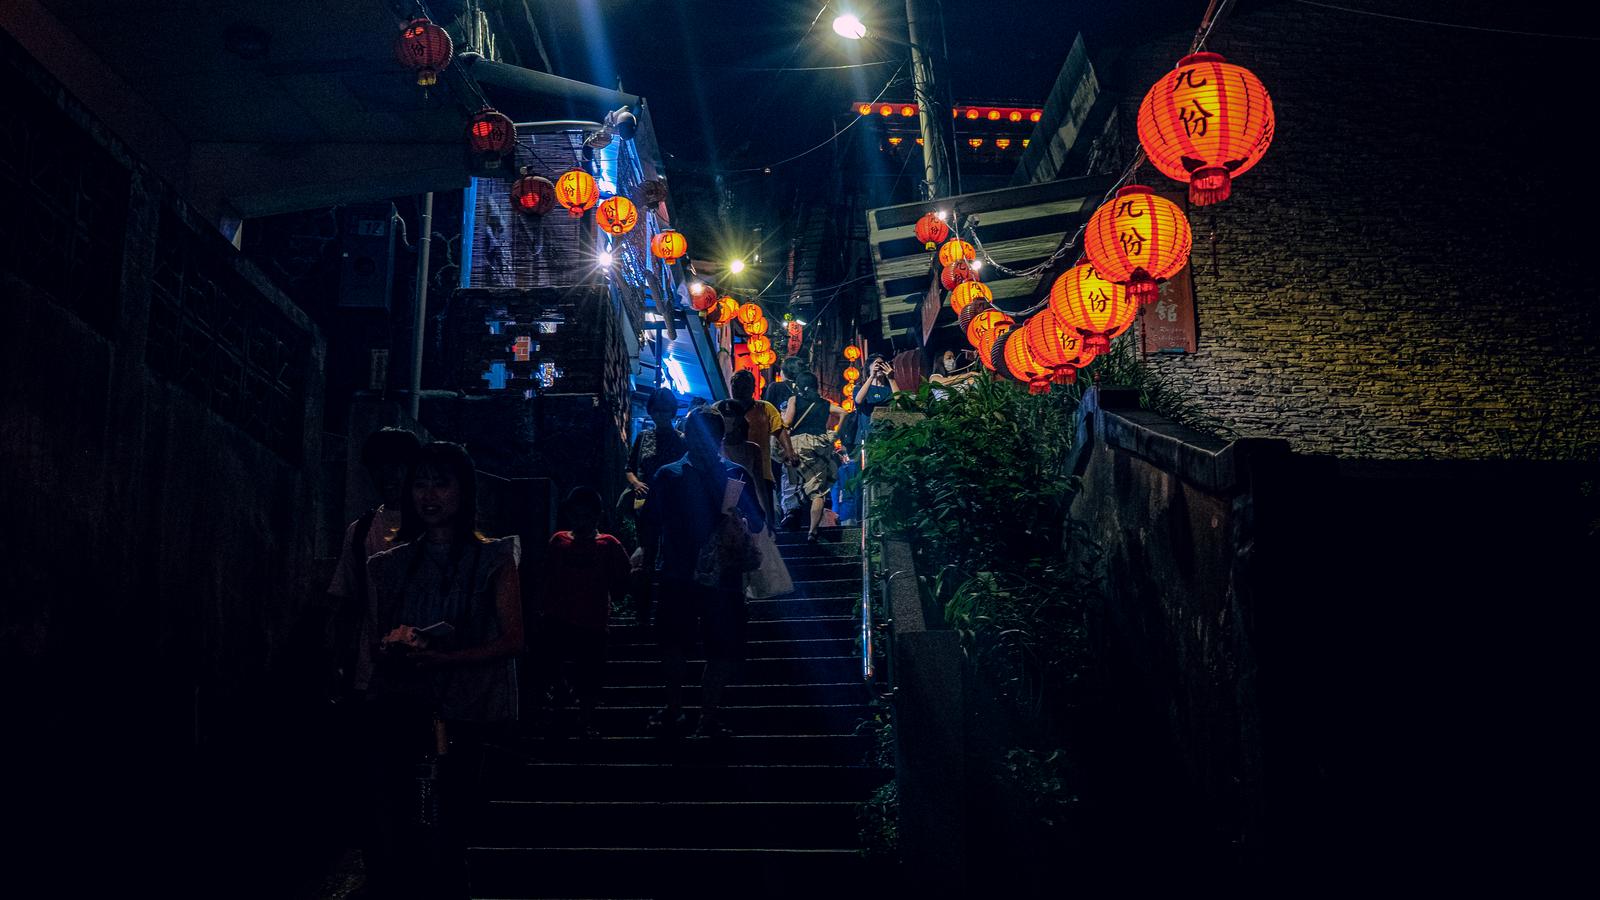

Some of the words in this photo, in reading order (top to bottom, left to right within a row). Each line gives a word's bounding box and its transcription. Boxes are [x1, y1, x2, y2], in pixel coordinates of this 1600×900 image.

[1172, 68, 1214, 139] 九份
[564, 174, 575, 197] 九份
[661, 234, 673, 256] 九份
[1115, 200, 1146, 257] 九份
[955, 260, 968, 283] 九份
[1084, 266, 1112, 313] 九份
